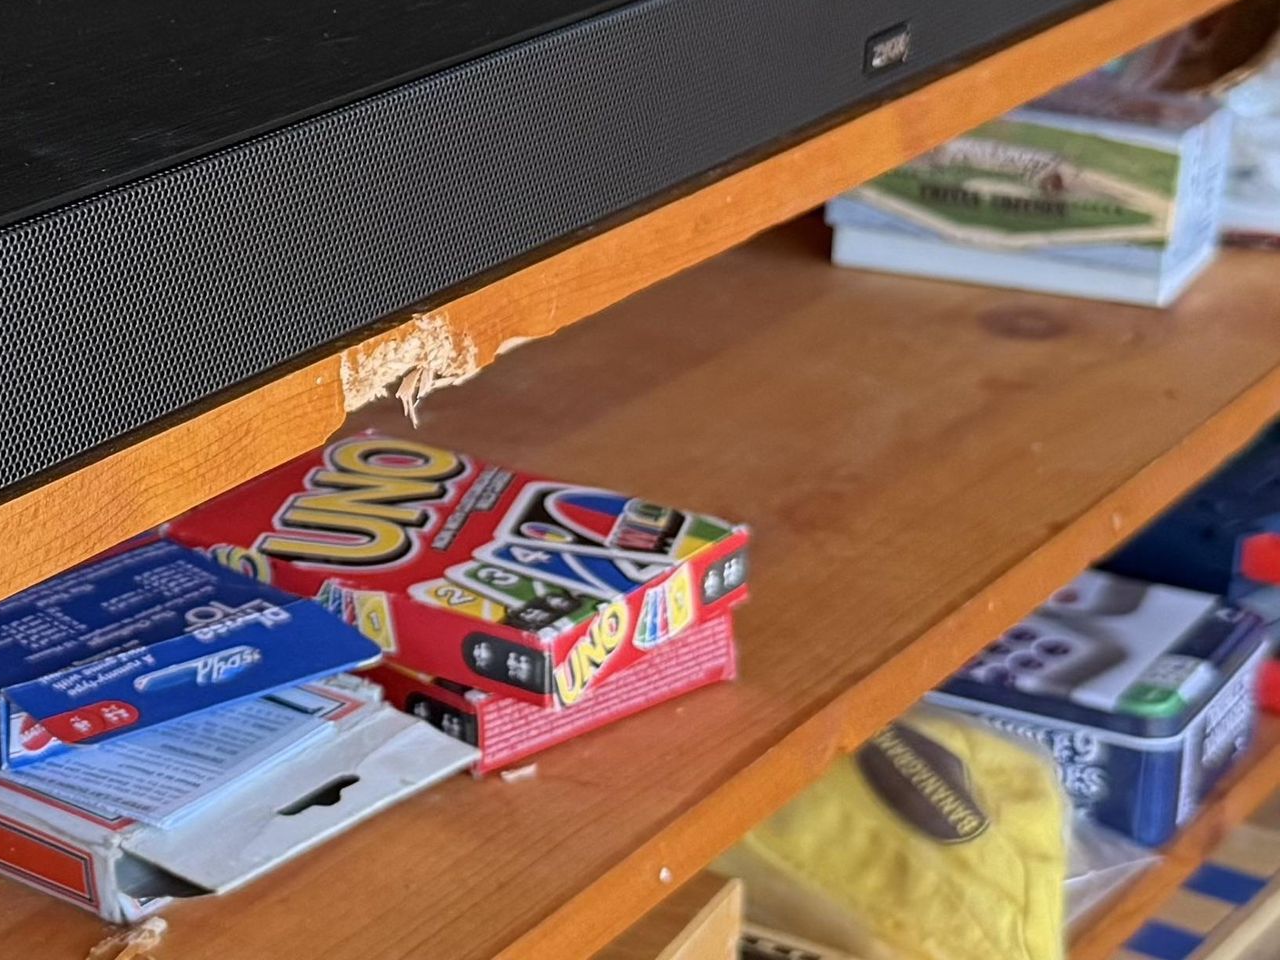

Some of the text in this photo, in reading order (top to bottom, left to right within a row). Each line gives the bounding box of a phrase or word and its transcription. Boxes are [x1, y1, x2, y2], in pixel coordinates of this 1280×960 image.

[255, 438, 467, 568] UNO
[435, 586, 476, 607] 2
[555, 601, 627, 707] UNO
[870, 724, 983, 836] BANANAGRAM
